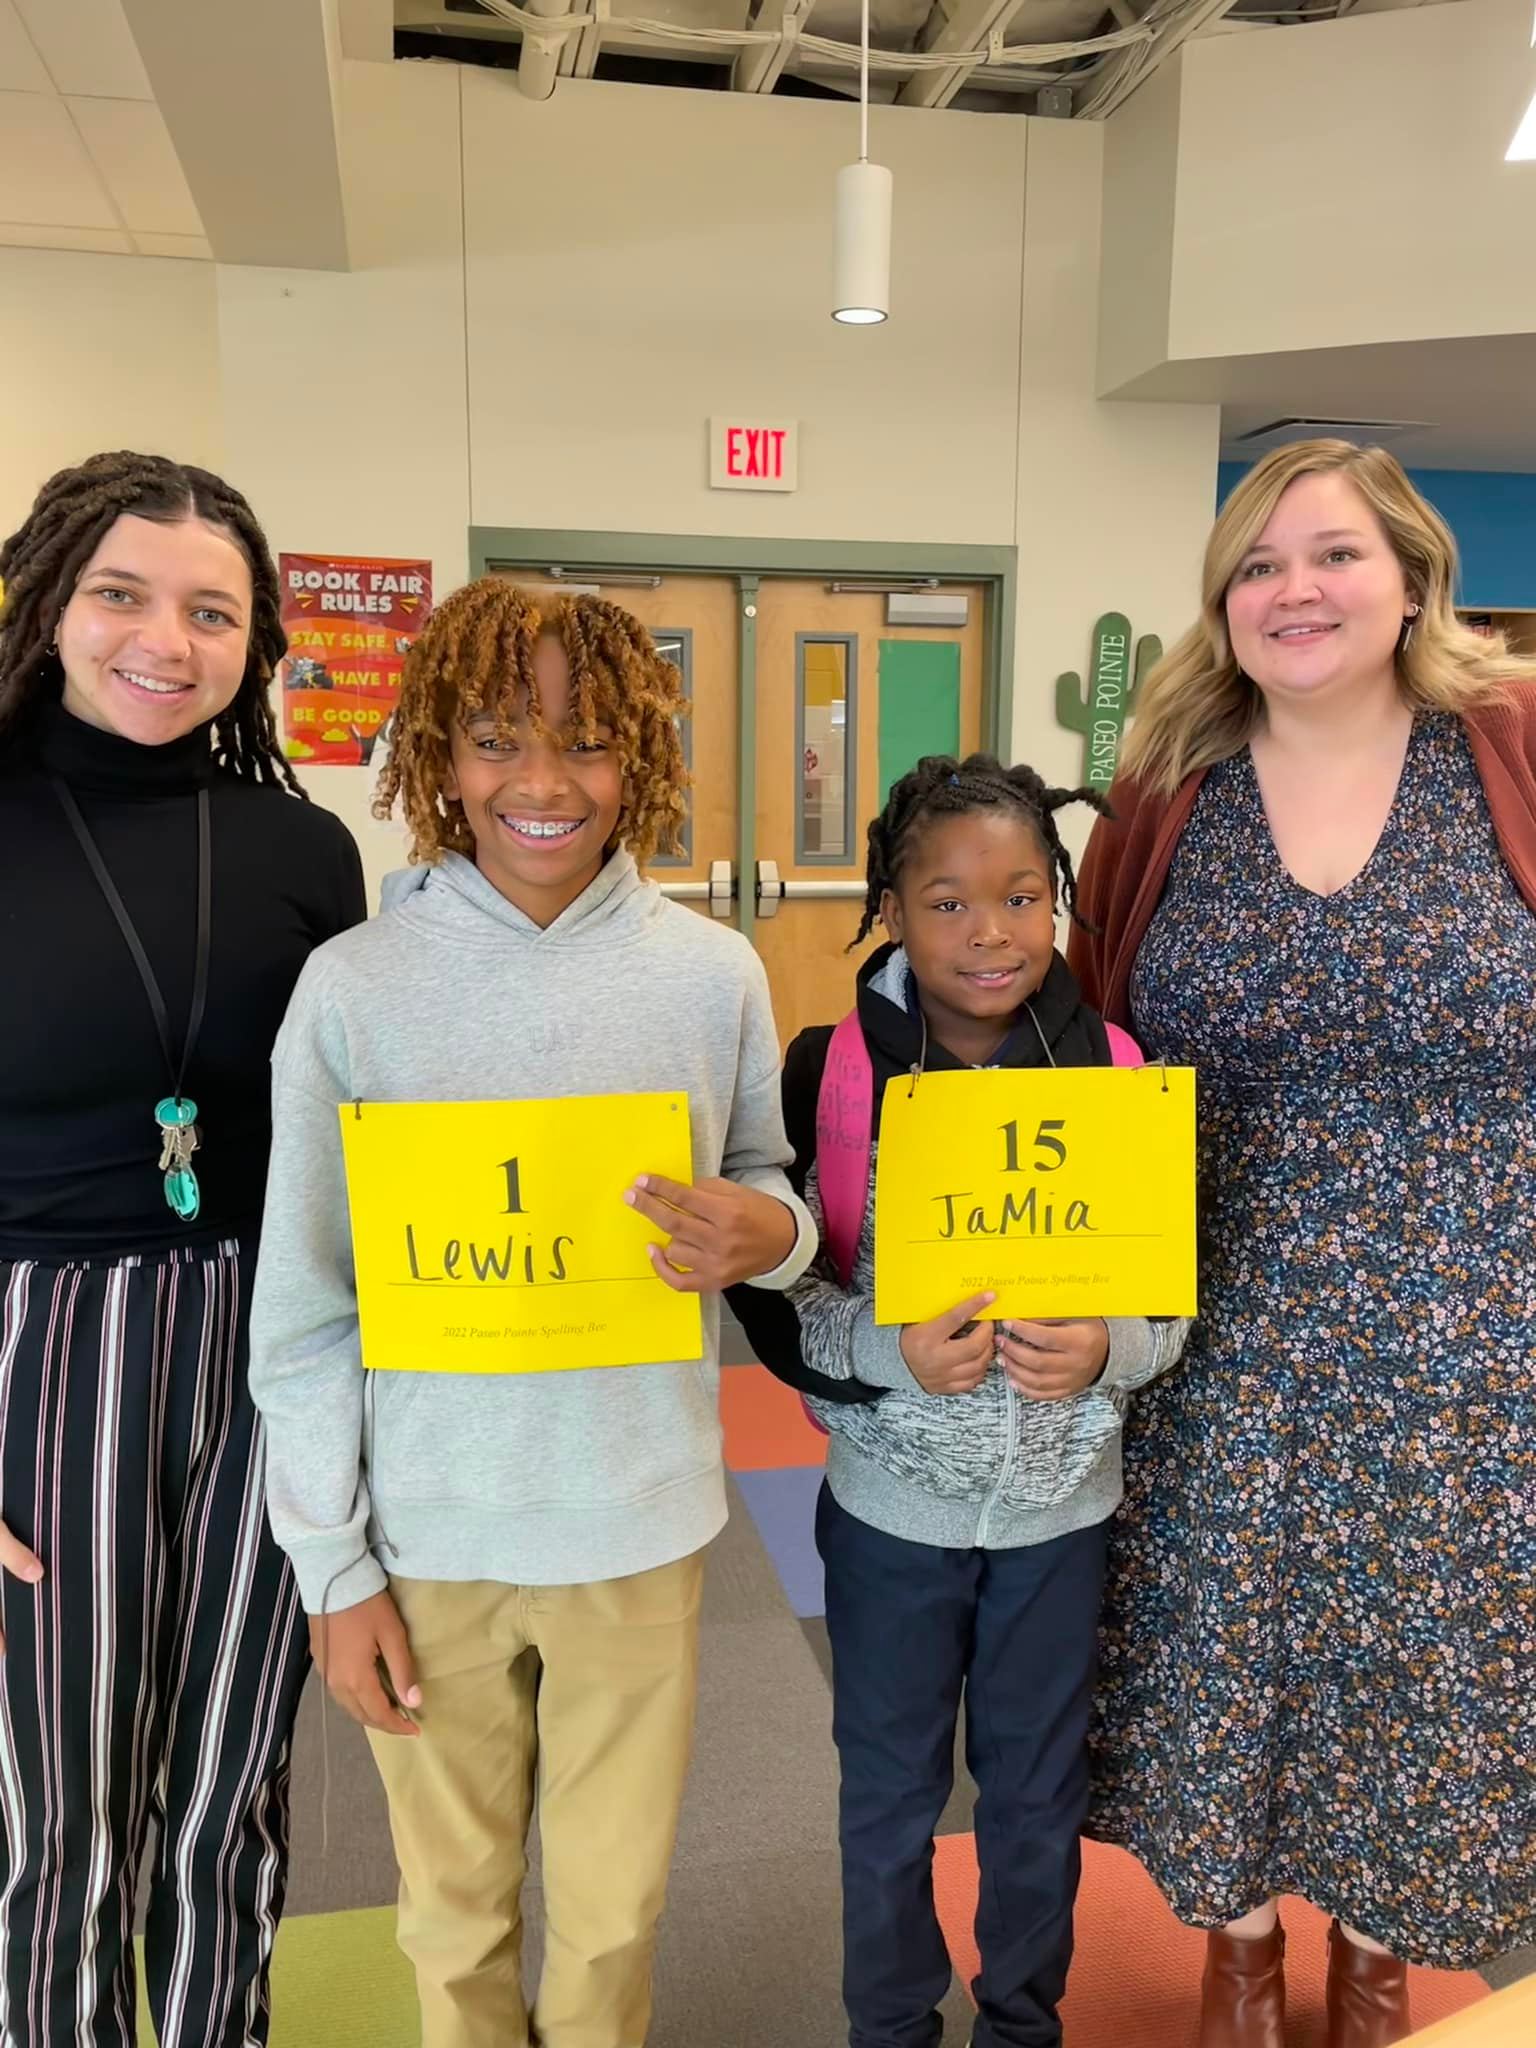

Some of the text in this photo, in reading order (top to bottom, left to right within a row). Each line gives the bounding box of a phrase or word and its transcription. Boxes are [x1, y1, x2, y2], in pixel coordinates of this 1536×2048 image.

[727, 427, 787, 478] EXIT
[288, 569, 424, 595] BOOK FAIR
[320, 592, 393, 614] RULES
[290, 632, 336, 646] STAY
[331, 670, 380, 687] HAVE
[293, 708, 315, 721] BE
[1089, 633, 1126, 782] PASEO POINTE
[997, 1119, 1067, 1172] 15
[496, 1156, 530, 1214] 1
[930, 1186, 1099, 1239] JaMia
[406, 1223, 575, 1284] Lewis
[442, 1321, 608, 1340] 2022 Paseo Pointe Spelling Bee
